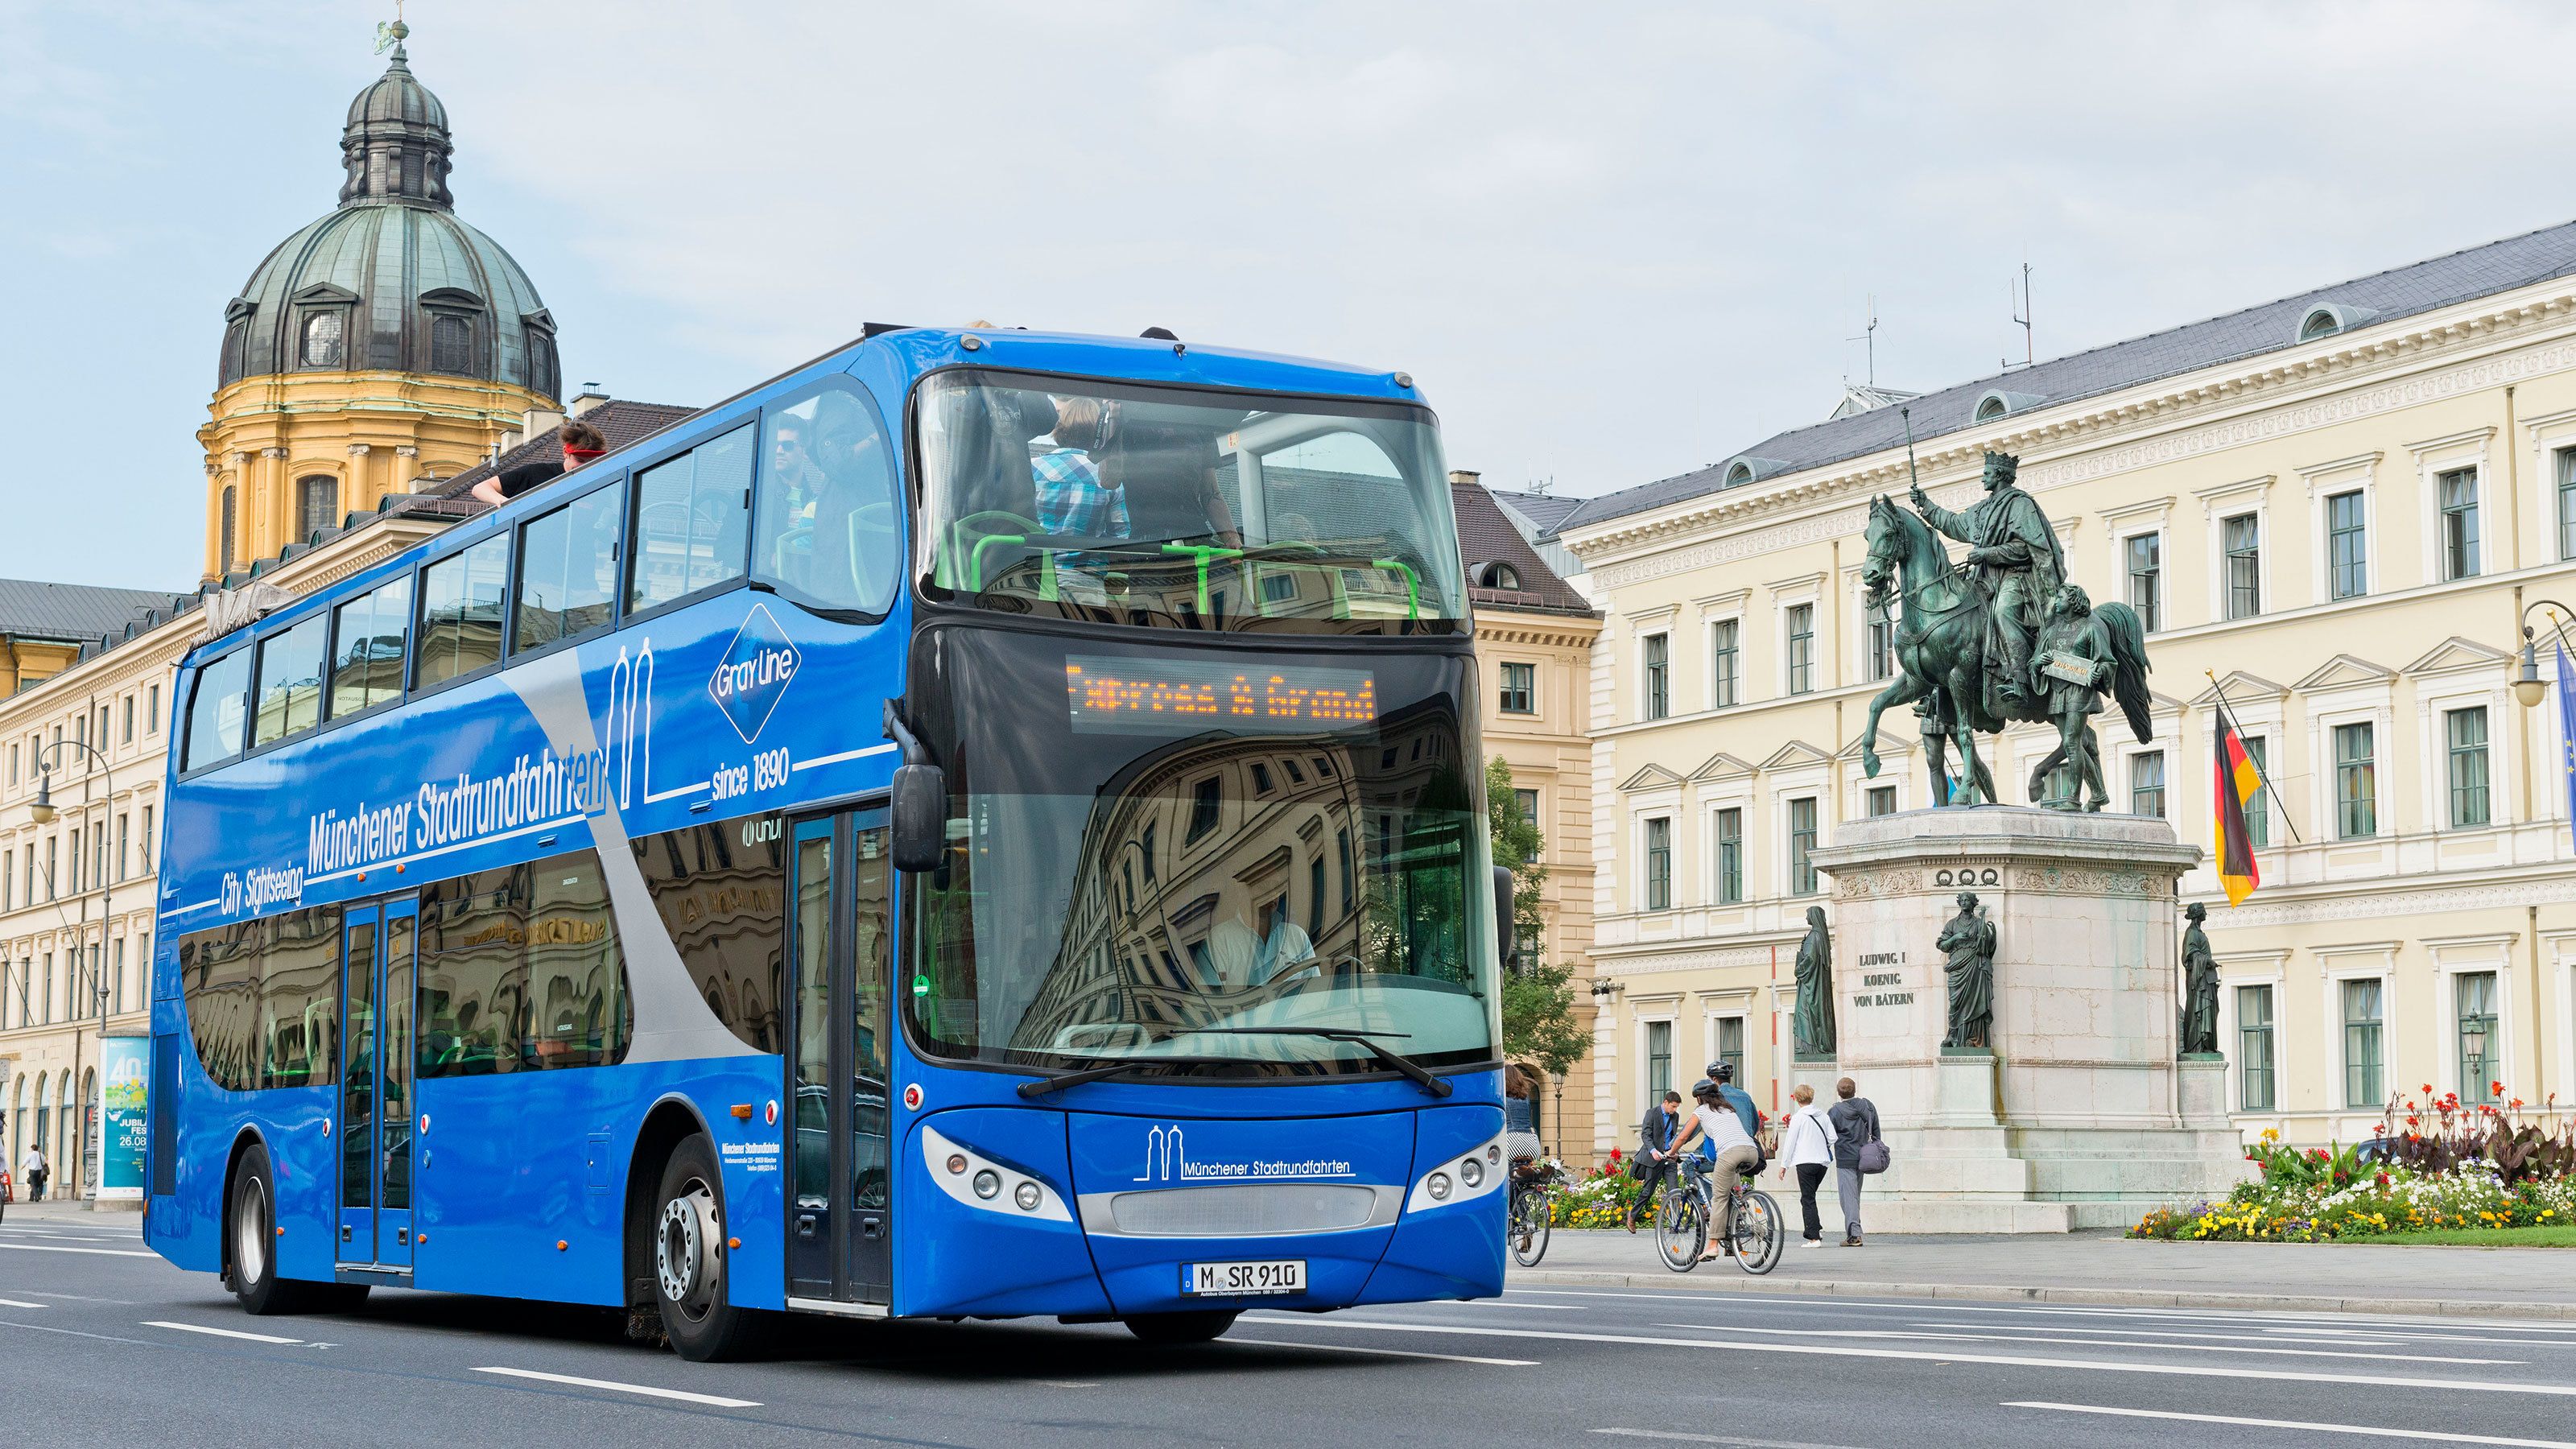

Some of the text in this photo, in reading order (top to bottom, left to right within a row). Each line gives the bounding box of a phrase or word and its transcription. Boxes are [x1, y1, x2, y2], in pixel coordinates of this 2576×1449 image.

[712, 746, 790, 801] since 1890
[308, 744, 607, 875] Münchener Stadtrundfahrten
[221, 861, 303, 917] City Sightseeing
[1859, 952, 1905, 966] LUDWIG I
[918, 976, 923, 987] 4
[1864, 973, 1901, 986] KOENIG
[1853, 993, 1913, 1007] VON BAYERN
[109, 1055, 142, 1082] 40
[1184, 1160, 1350, 1176] Münchener Stadtrundfahrten
[1201, 1265, 1295, 1288] M SR 910
